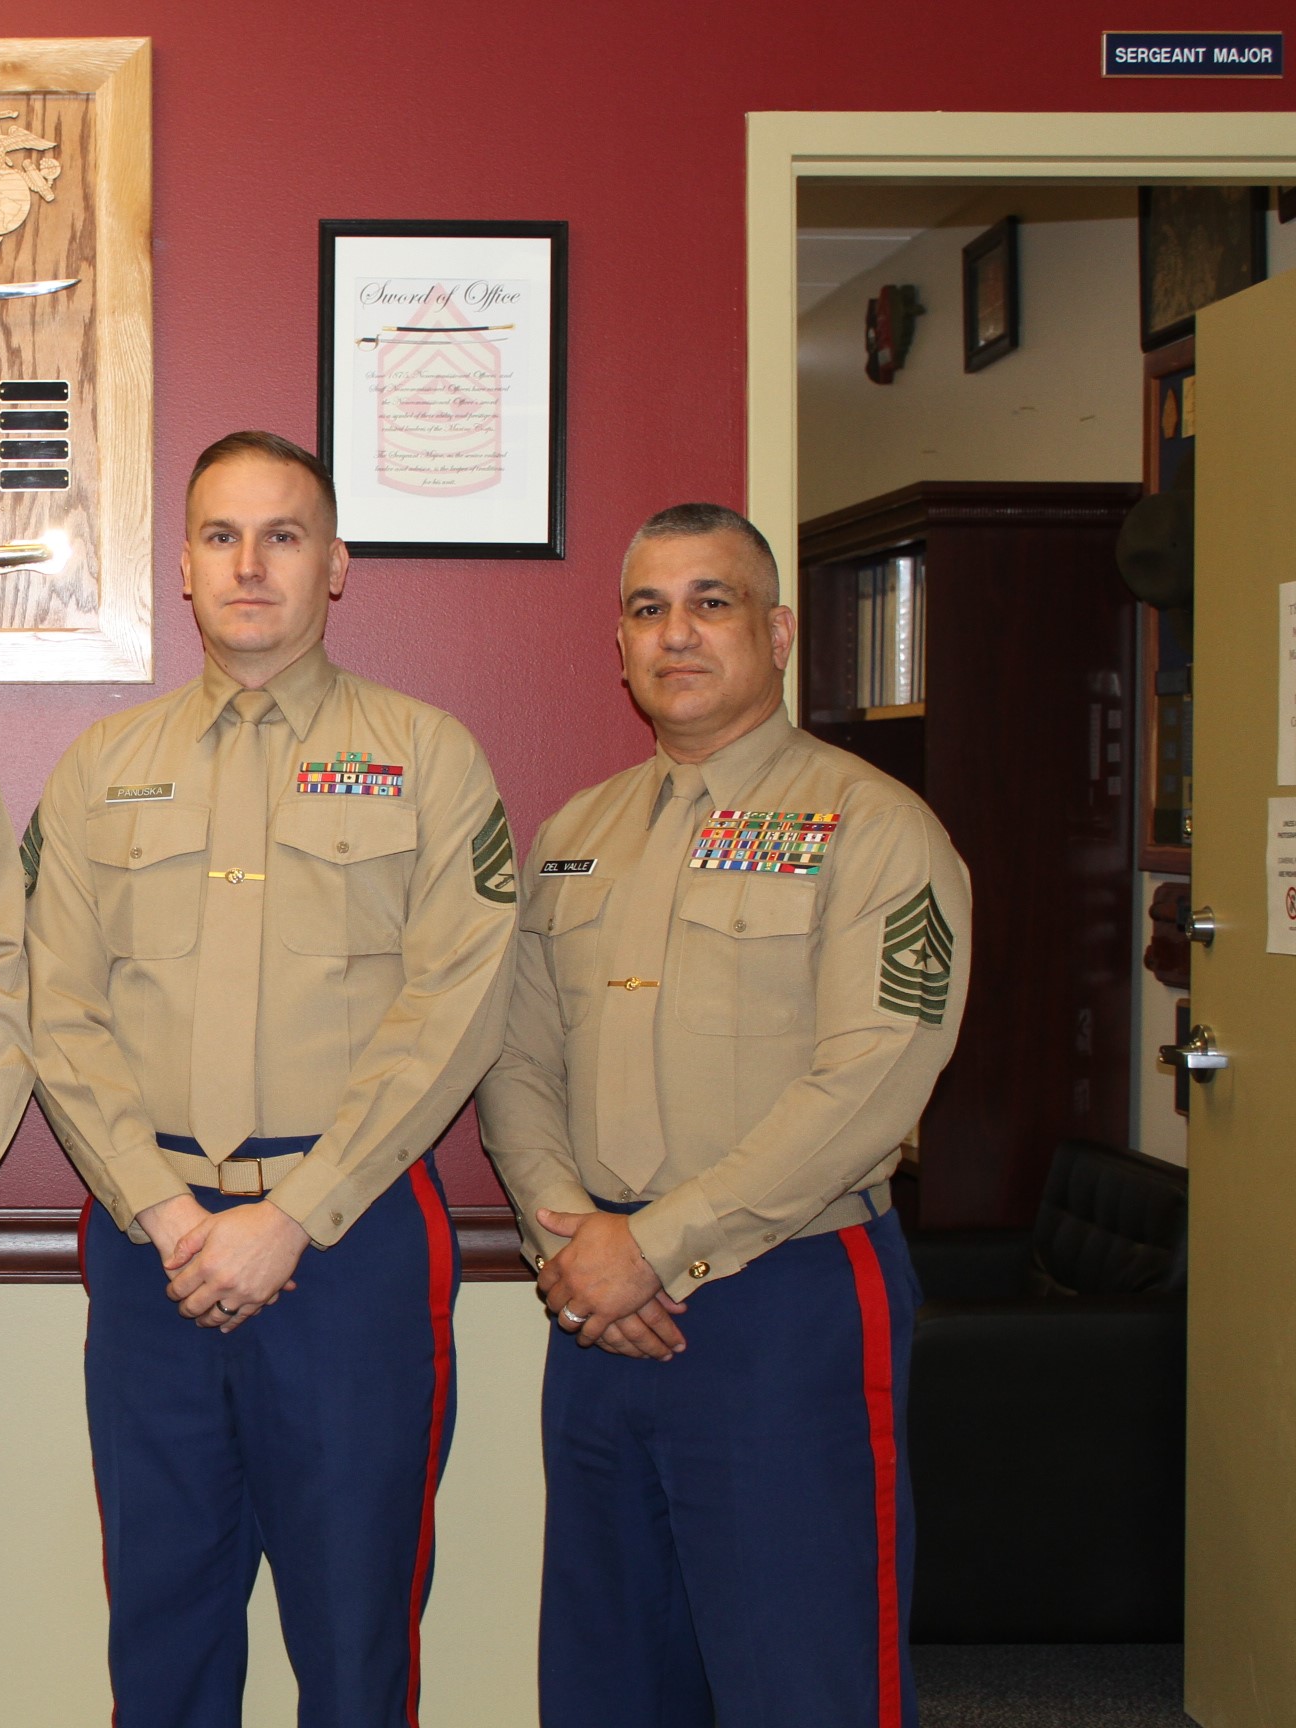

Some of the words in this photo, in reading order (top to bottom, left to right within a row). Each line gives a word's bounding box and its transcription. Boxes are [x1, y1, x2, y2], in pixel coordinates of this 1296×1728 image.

[1115, 47, 1206, 63] SERGEANT
[1213, 47, 1272, 63] MAJOR
[359, 279, 435, 310] Sword
[435, 284, 459, 313] of
[463, 279, 521, 313] Office
[117, 786, 163, 797] PANUSKA
[544, 863, 559, 871] DEL
[564, 862, 590, 871] VALLE
